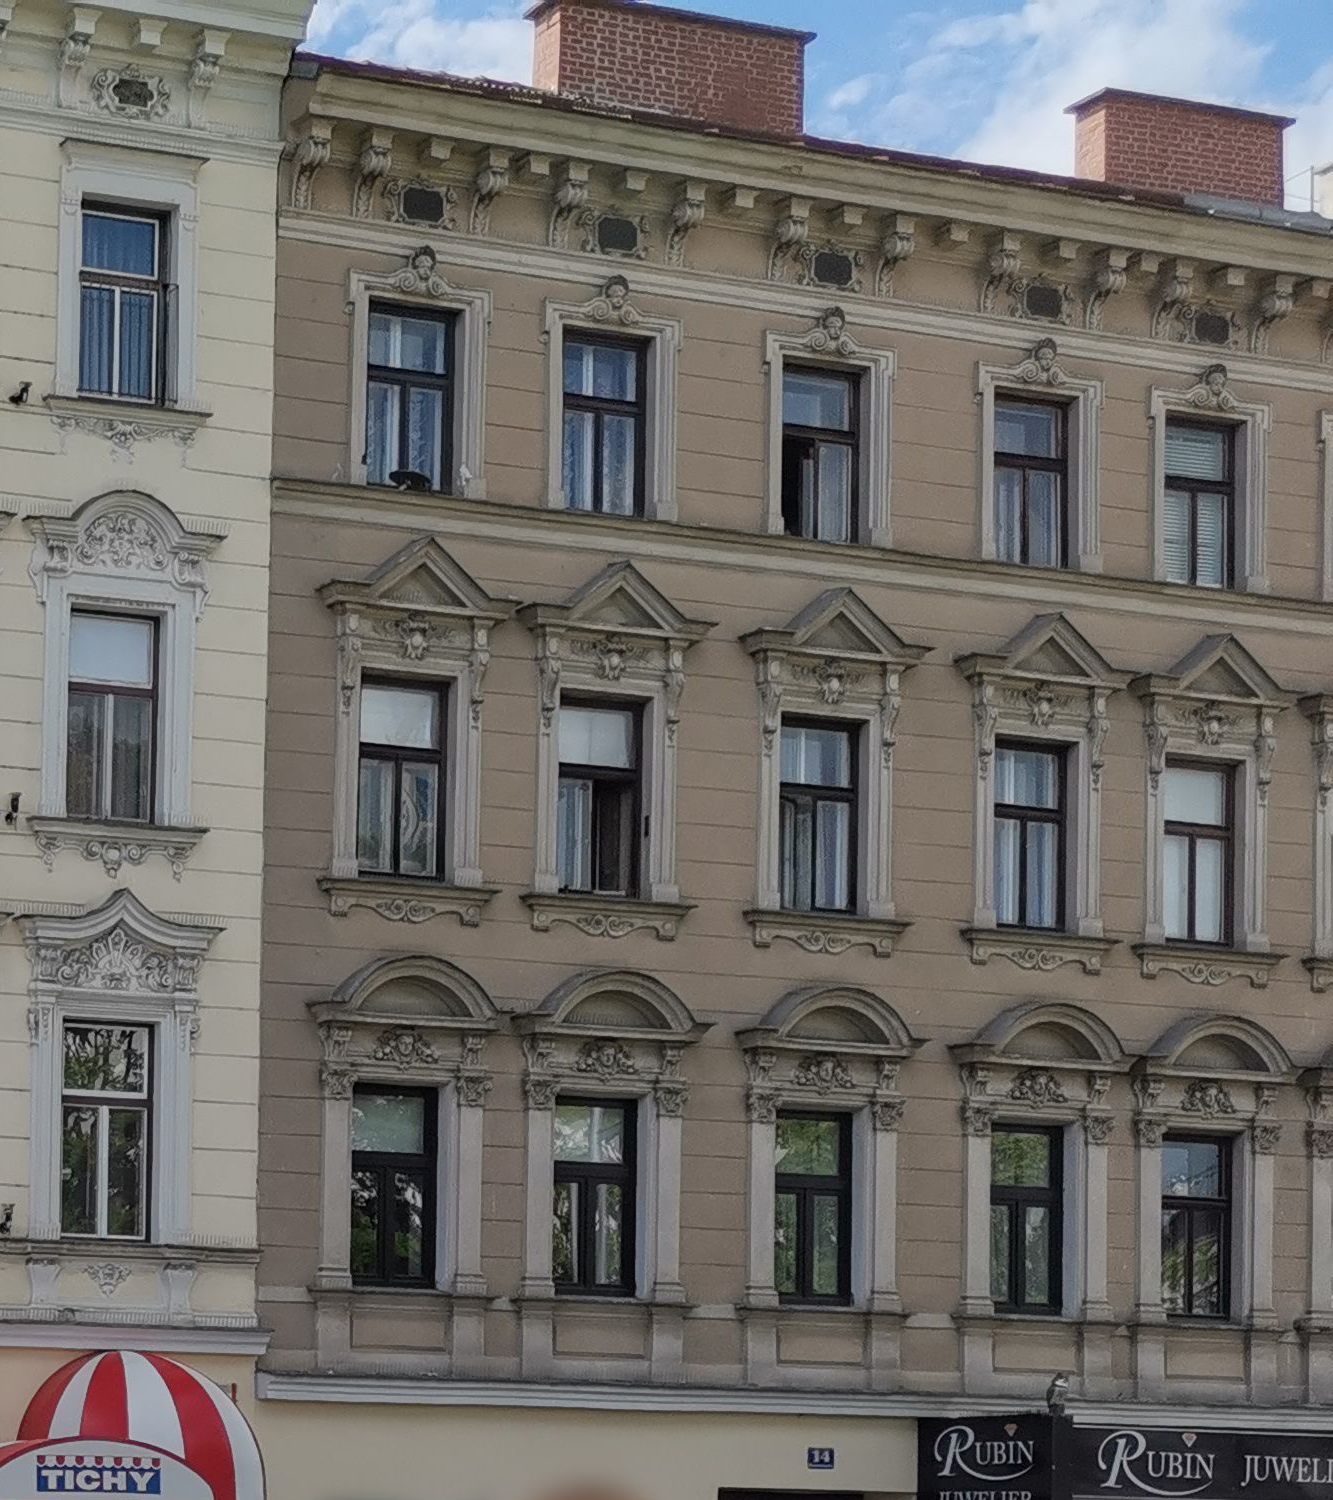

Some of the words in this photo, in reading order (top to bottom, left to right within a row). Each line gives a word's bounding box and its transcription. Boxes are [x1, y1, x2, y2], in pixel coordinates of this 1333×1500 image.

[812, 1450, 831, 1463] 14
[934, 1425, 1035, 1481] RUBIN
[1098, 1430, 1215, 1496] RUBIN
[41, 1468, 154, 1493] TICHY
